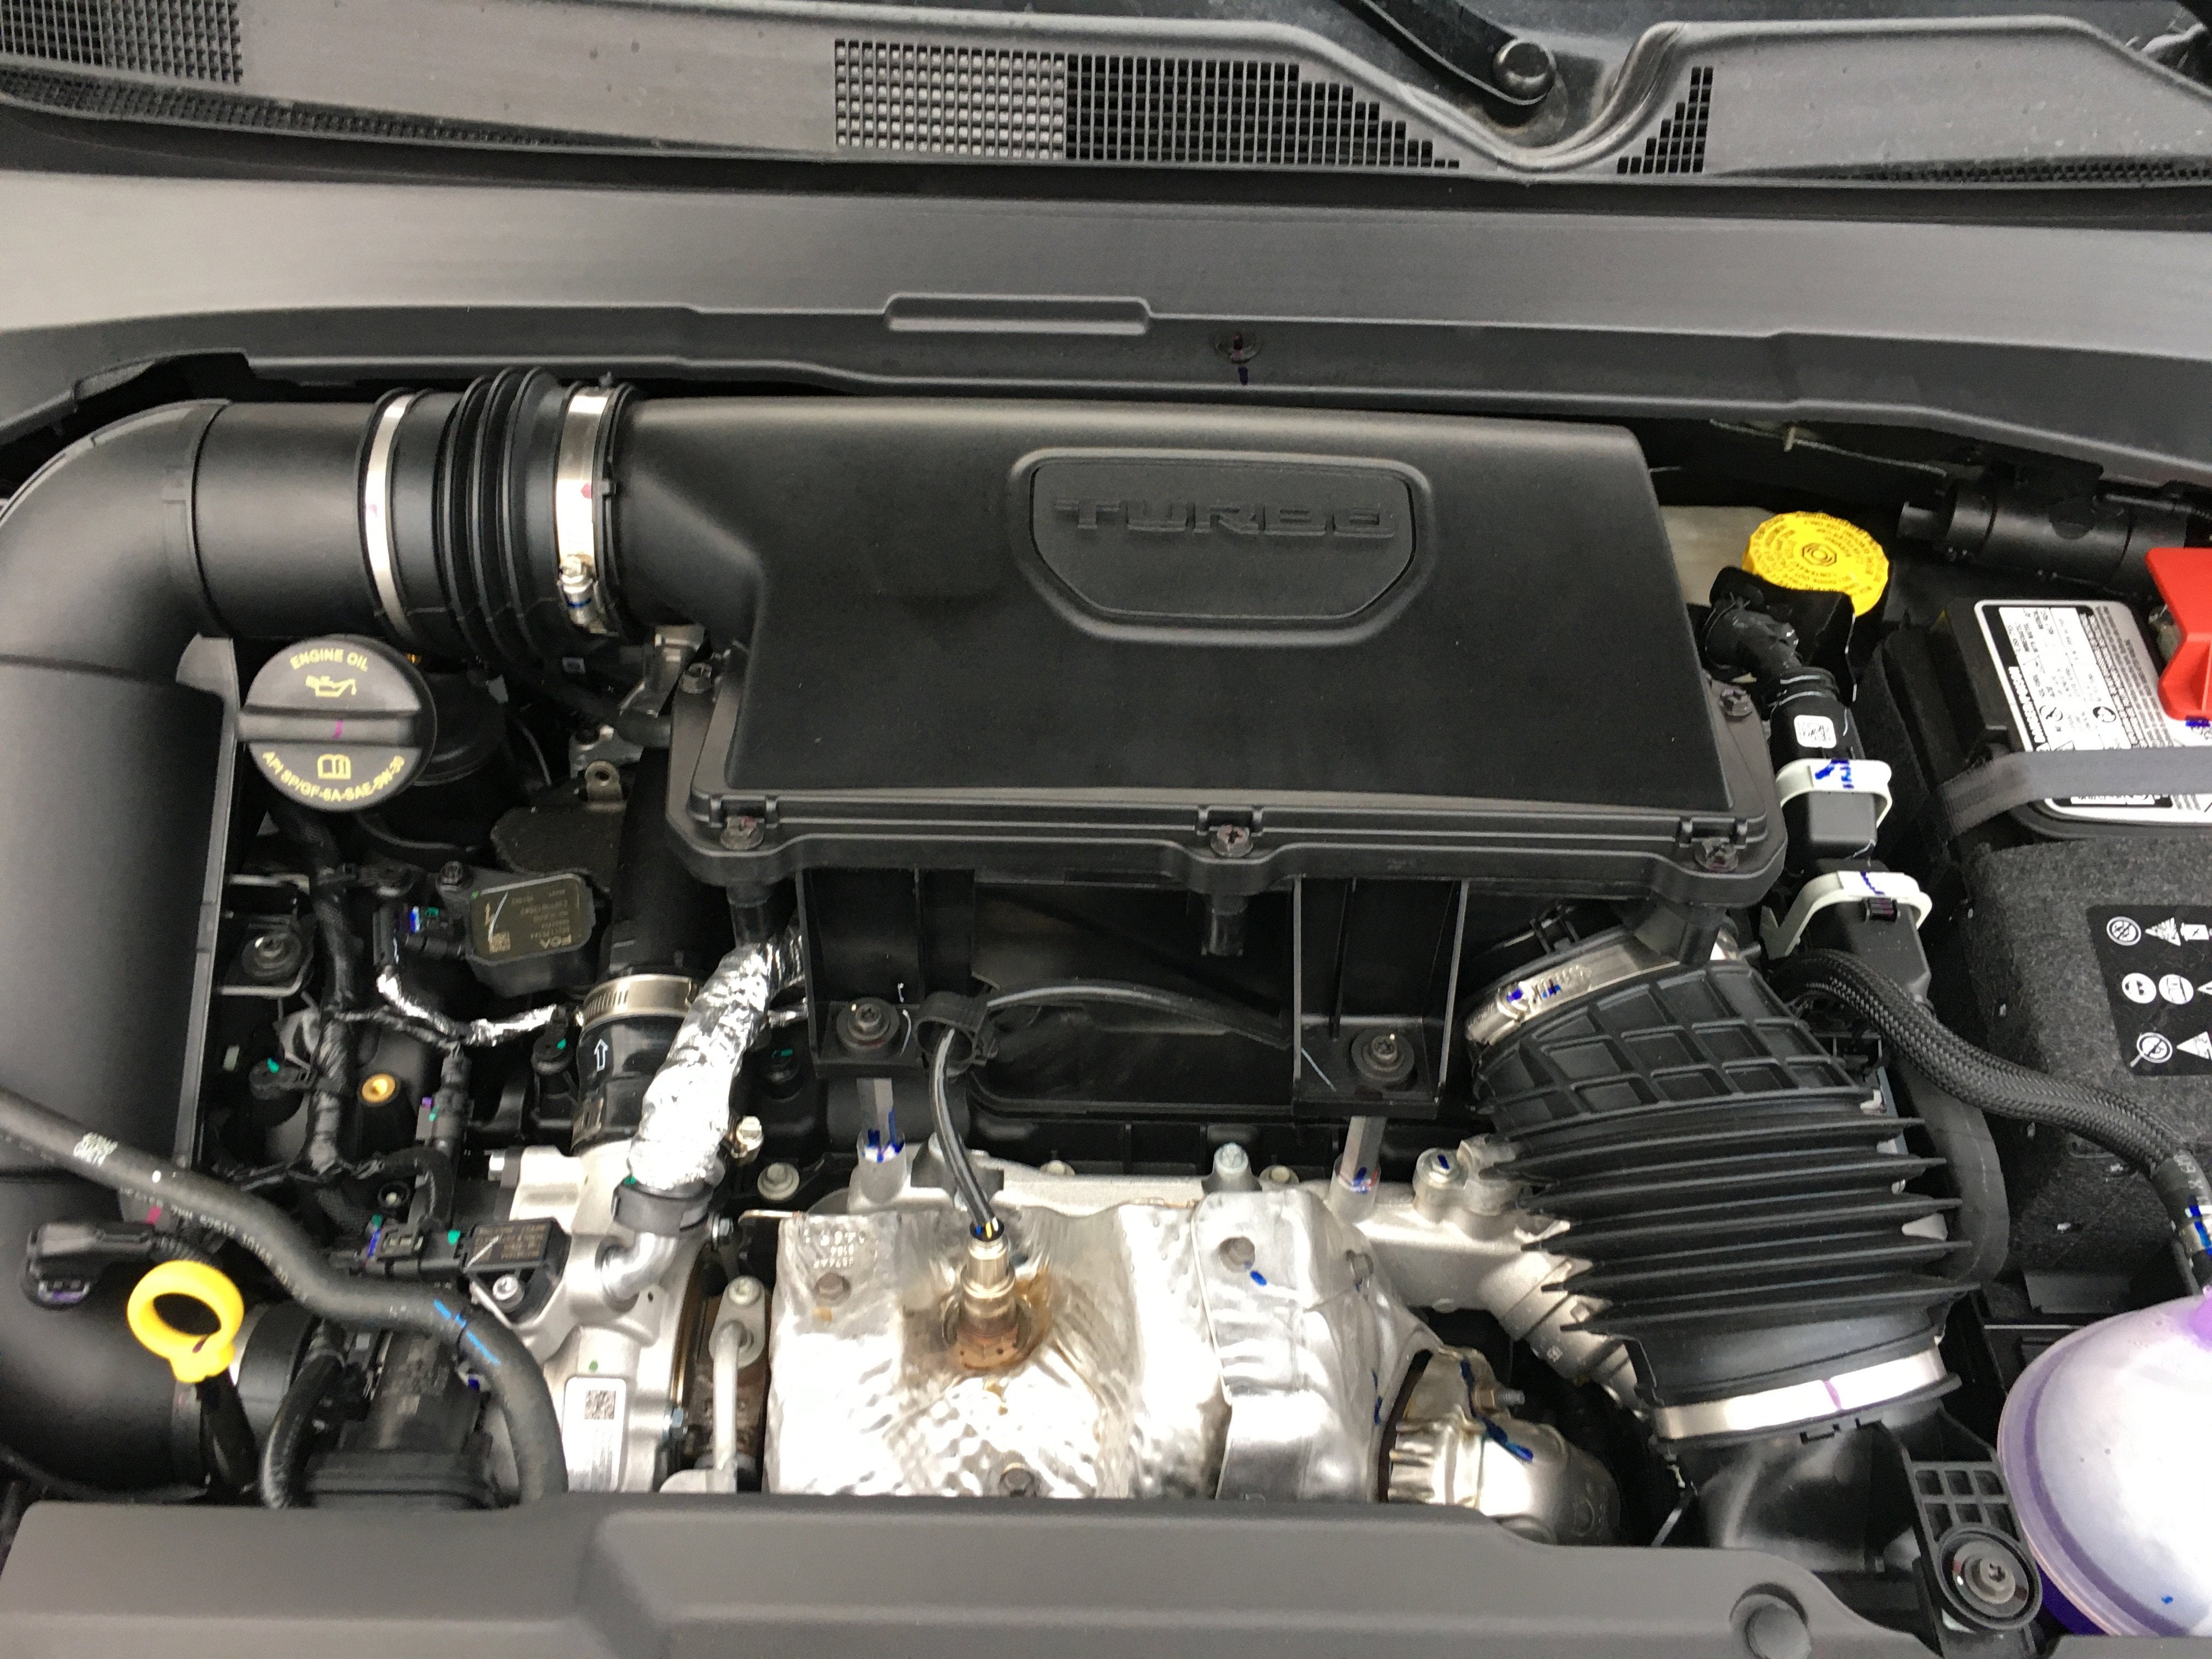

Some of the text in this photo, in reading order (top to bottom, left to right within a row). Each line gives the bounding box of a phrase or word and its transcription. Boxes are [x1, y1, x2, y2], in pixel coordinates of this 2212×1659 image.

[1054, 497, 1395, 539] TURBO
[290, 648, 369, 672] ENGINE OIL
[262, 751, 284, 775] API
